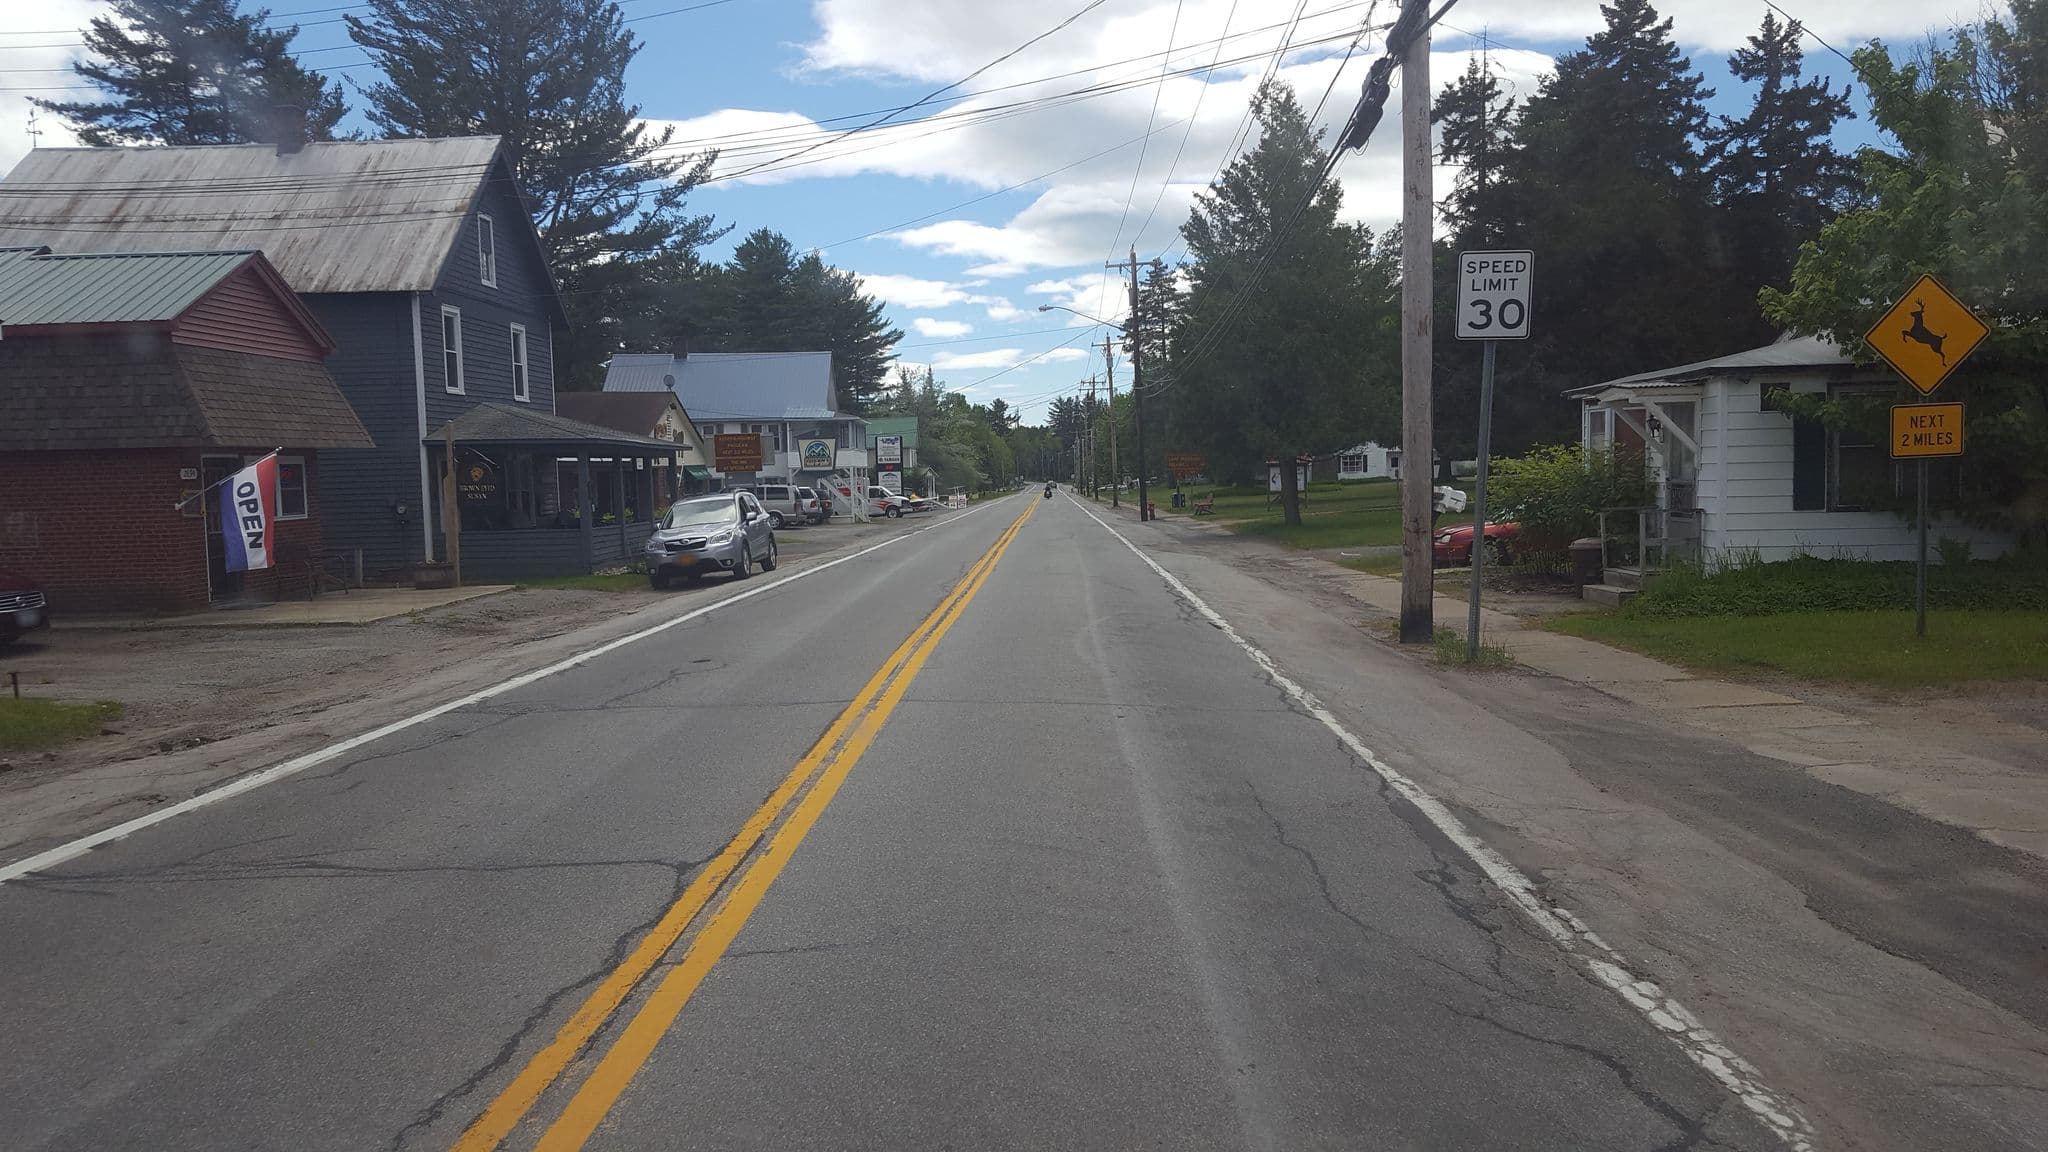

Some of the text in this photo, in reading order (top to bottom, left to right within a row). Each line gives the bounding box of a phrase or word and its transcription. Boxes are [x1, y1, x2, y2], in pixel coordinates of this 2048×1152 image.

[1466, 260, 1526, 273] SPEED
[1471, 278, 1519, 291] LIMIT
[1468, 298, 1525, 330] 30
[1910, 414, 1945, 428] NEXT
[1901, 432, 1953, 447] 2 MILES
[236, 481, 263, 549] OPEN
